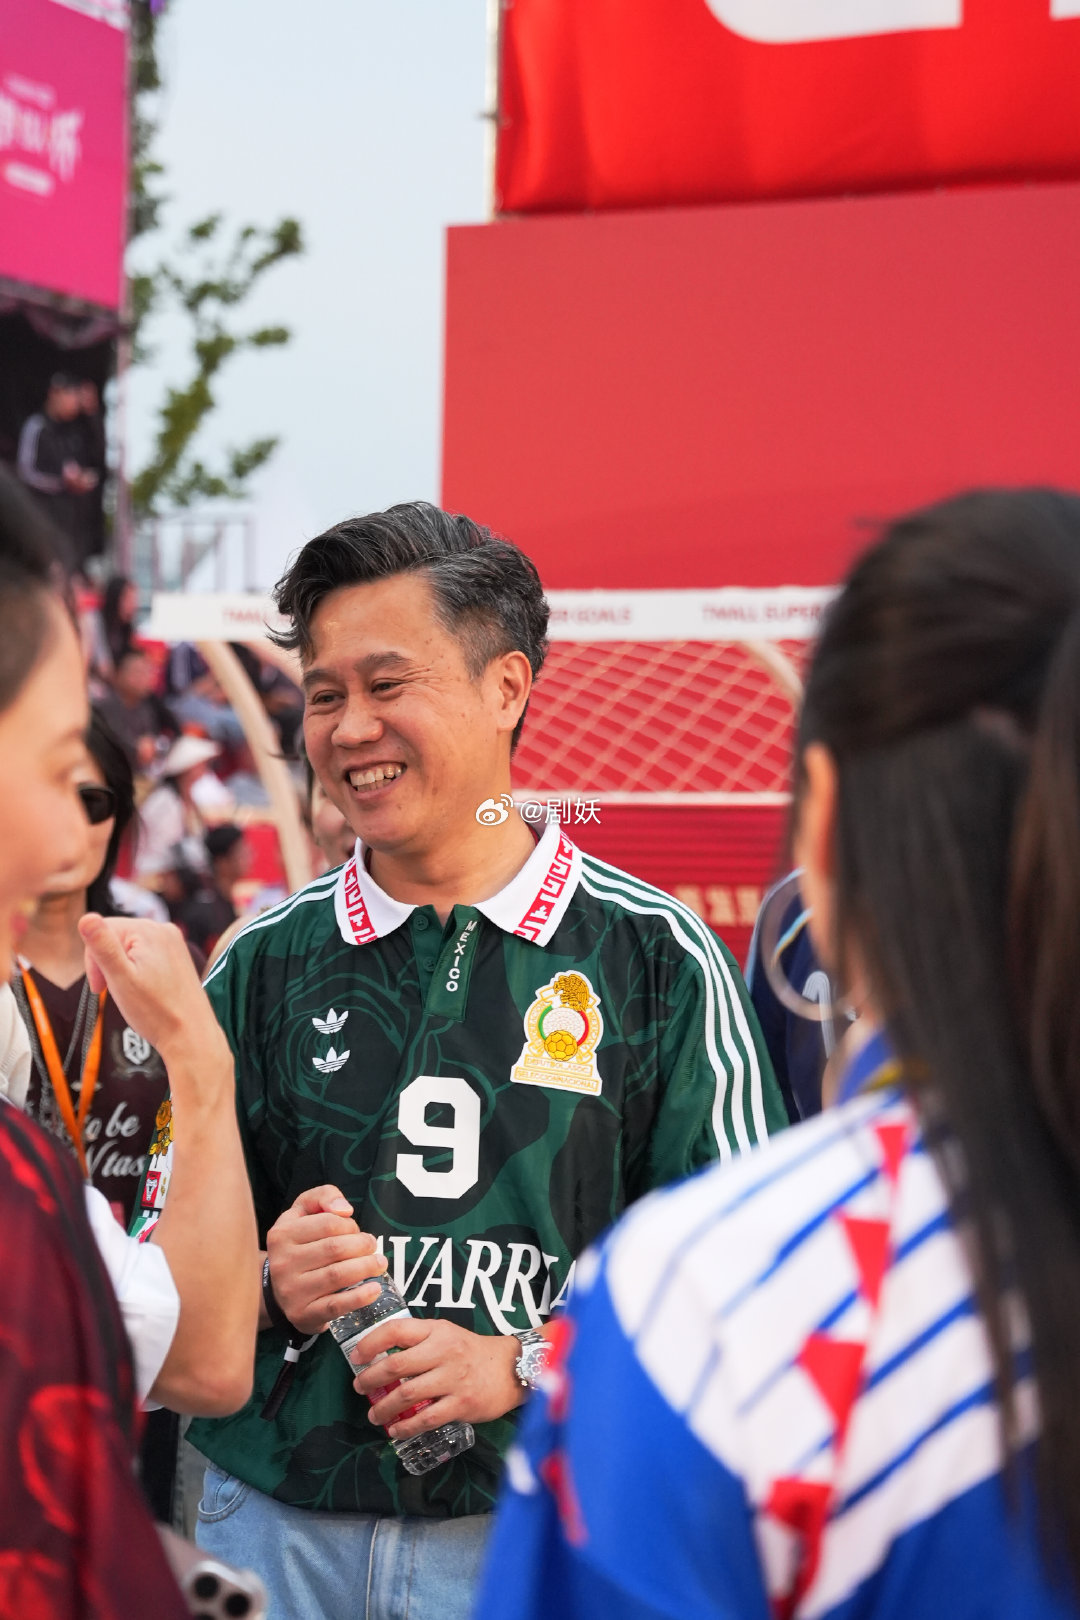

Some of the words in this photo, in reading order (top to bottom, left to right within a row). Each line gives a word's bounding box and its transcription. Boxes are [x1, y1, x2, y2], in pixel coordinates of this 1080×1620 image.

[445, 920, 478, 992] MEXICO
[105, 1102, 141, 1137] be
[396, 1075, 481, 1199] 9
